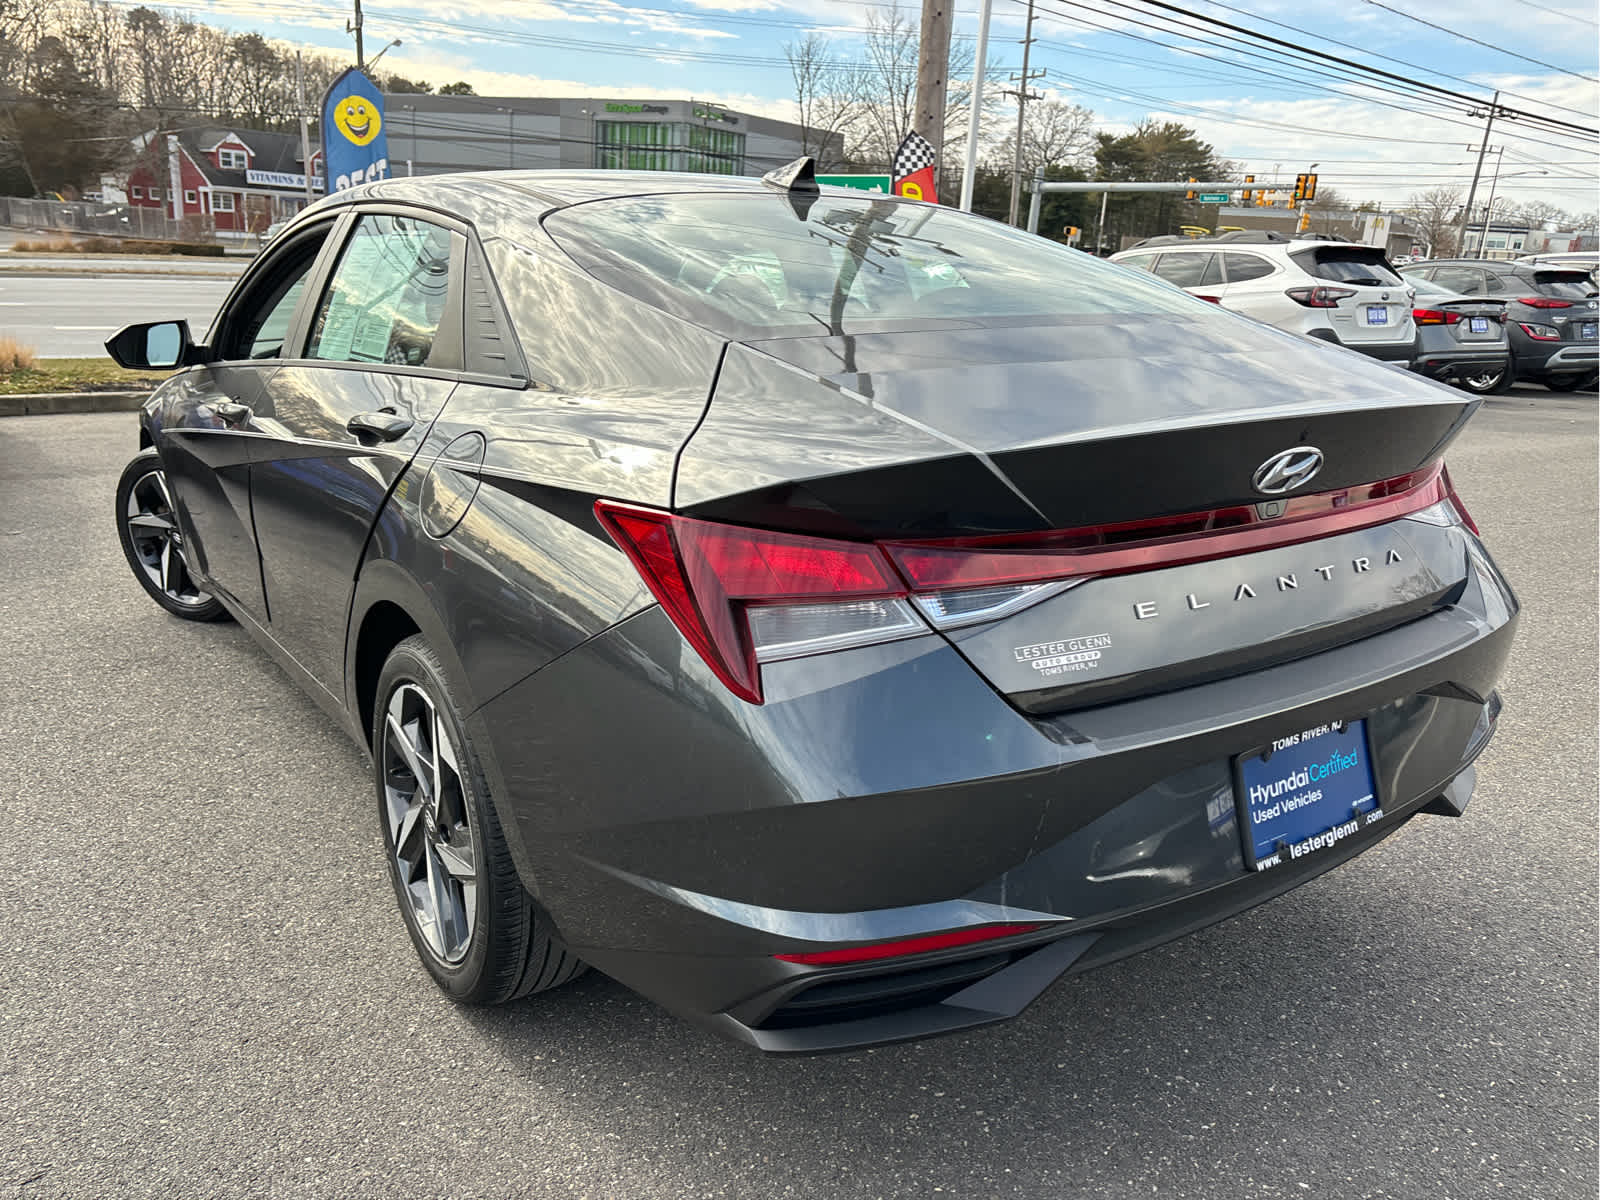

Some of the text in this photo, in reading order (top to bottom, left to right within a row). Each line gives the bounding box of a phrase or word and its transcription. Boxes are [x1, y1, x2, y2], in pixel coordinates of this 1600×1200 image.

[249, 171, 295, 185] VITAMINS
[1134, 549, 1403, 620] ELANTRA
[1014, 635, 1112, 660] LESTER GLENN
[1033, 651, 1100, 668] AUTO GROUP
[1040, 667, 1063, 677] TOMS
[1271, 719, 1343, 752] TOMS RIVER, NJ
[1249, 748, 1358, 806] Hyundai Certified
[1253, 804, 1281, 825] Used
[1281, 789, 1323, 813] Vehicles
[1255, 853, 1283, 873] www.
[1290, 820, 1359, 859] lesterglenn
[1364, 808, 1385, 826] .com
